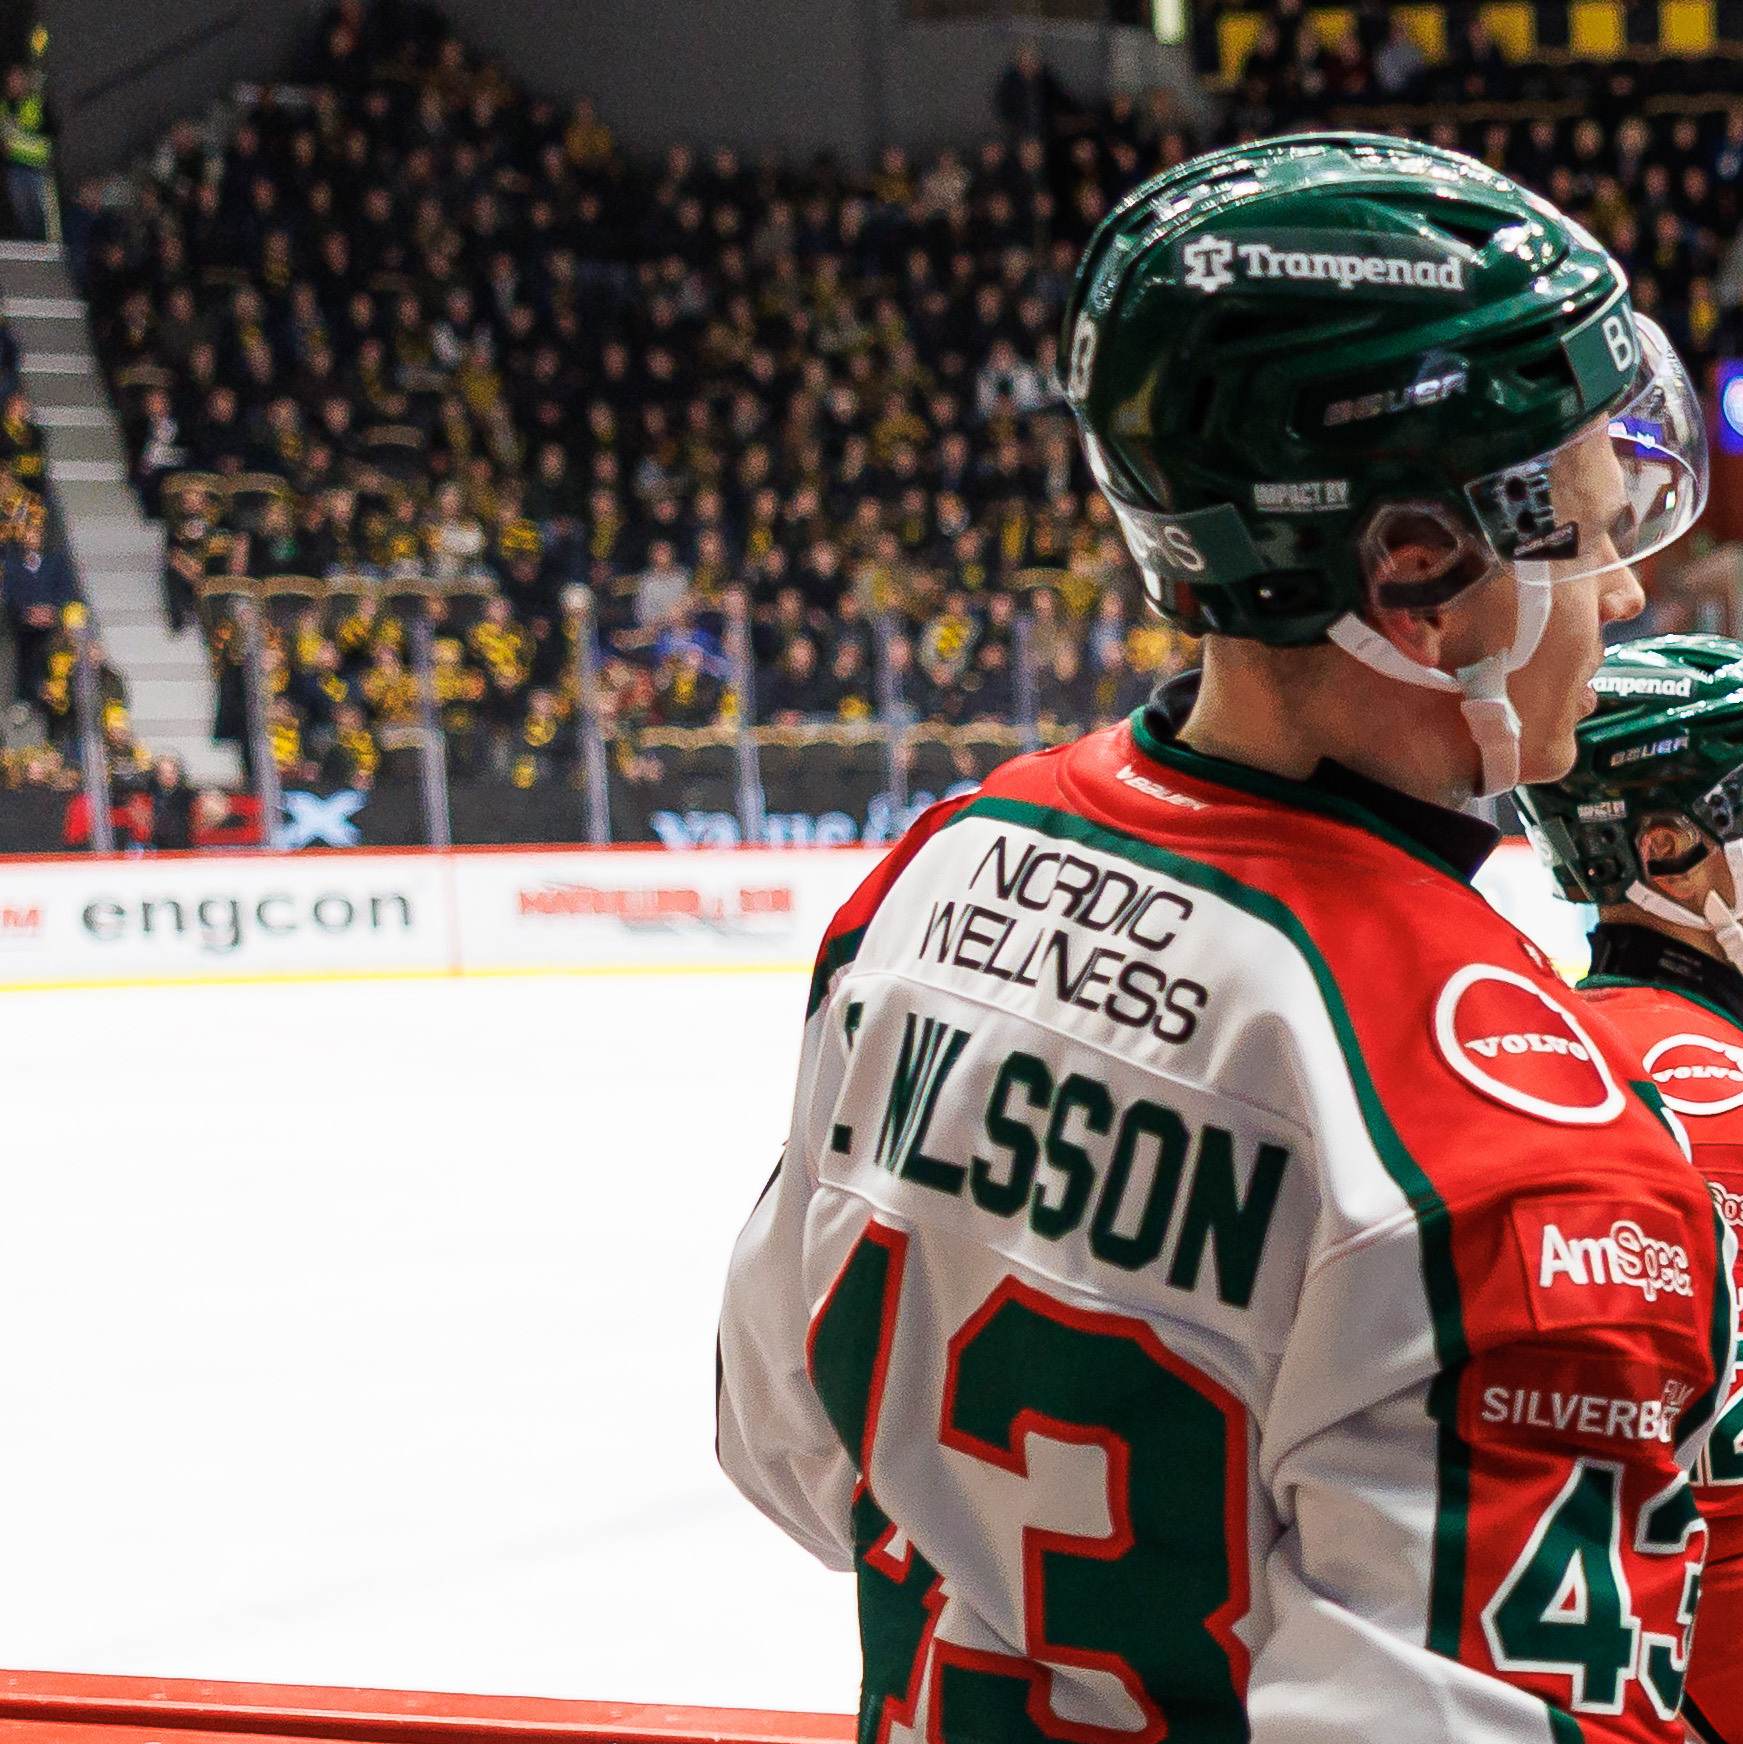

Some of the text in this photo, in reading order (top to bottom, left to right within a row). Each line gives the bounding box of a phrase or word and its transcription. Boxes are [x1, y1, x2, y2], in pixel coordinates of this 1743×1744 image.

[1239, 243, 1466, 292] Tranpenad
[81, 886, 413, 952] engcon
[918, 900, 1210, 1044] WELLNESS
[1465, 1032, 1590, 1060] VOLVO
[1480, 1456, 1708, 1722] 43
